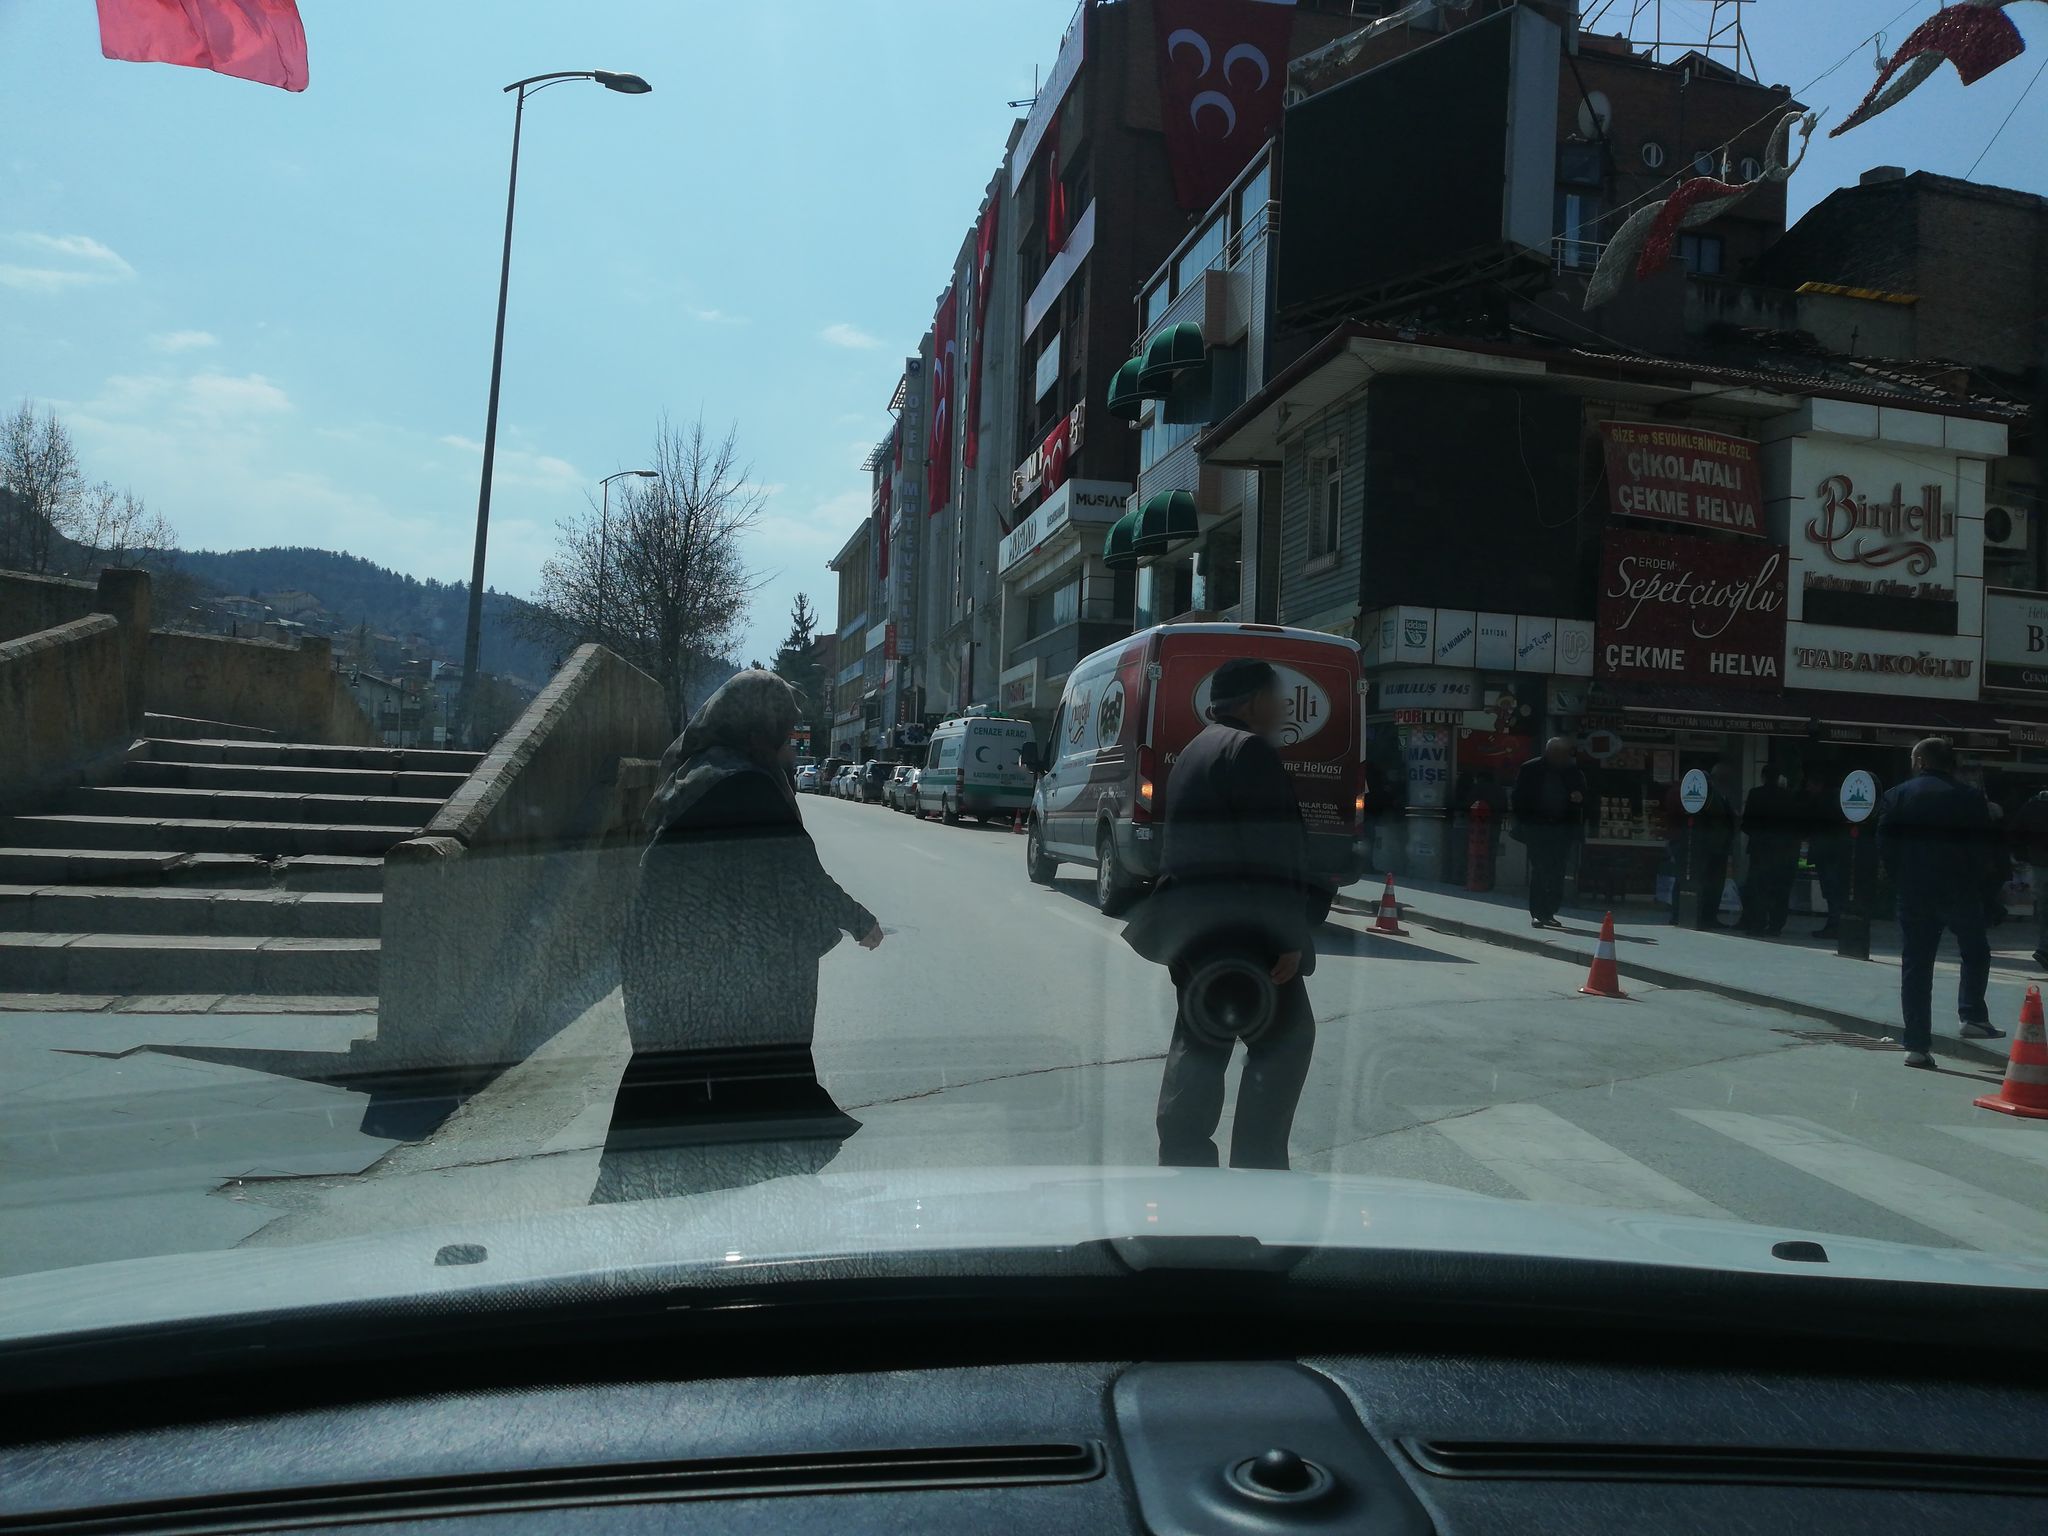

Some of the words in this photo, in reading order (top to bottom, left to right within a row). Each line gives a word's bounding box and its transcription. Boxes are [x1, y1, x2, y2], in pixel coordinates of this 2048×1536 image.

[1639, 433, 1649, 444] ve
[1628, 448, 1742, 490] ÇİKOLATALI
[1618, 485, 1689, 513] ÇEKME
[1697, 495, 1757, 528] HELVA
[1806, 474, 1955, 562] Bintelli
[1639, 557, 1676, 571] ERDEM
[1608, 553, 1783, 638] Sepetçioğlu
[1606, 644, 1685, 671] ÇEKME
[1710, 652, 1777, 677] HELVA
[1798, 648, 1973, 679] TABAKOĞLU
[1385, 684, 1437, 695] KURULUŞ
[1442, 684, 1470, 695] 1945
[973, 727, 1003, 737] CENAZE
[1005, 728, 1027, 738] ARACI
[1304, 762, 1343, 775] Helvası
[1408, 766, 1447, 785] GİŞE
